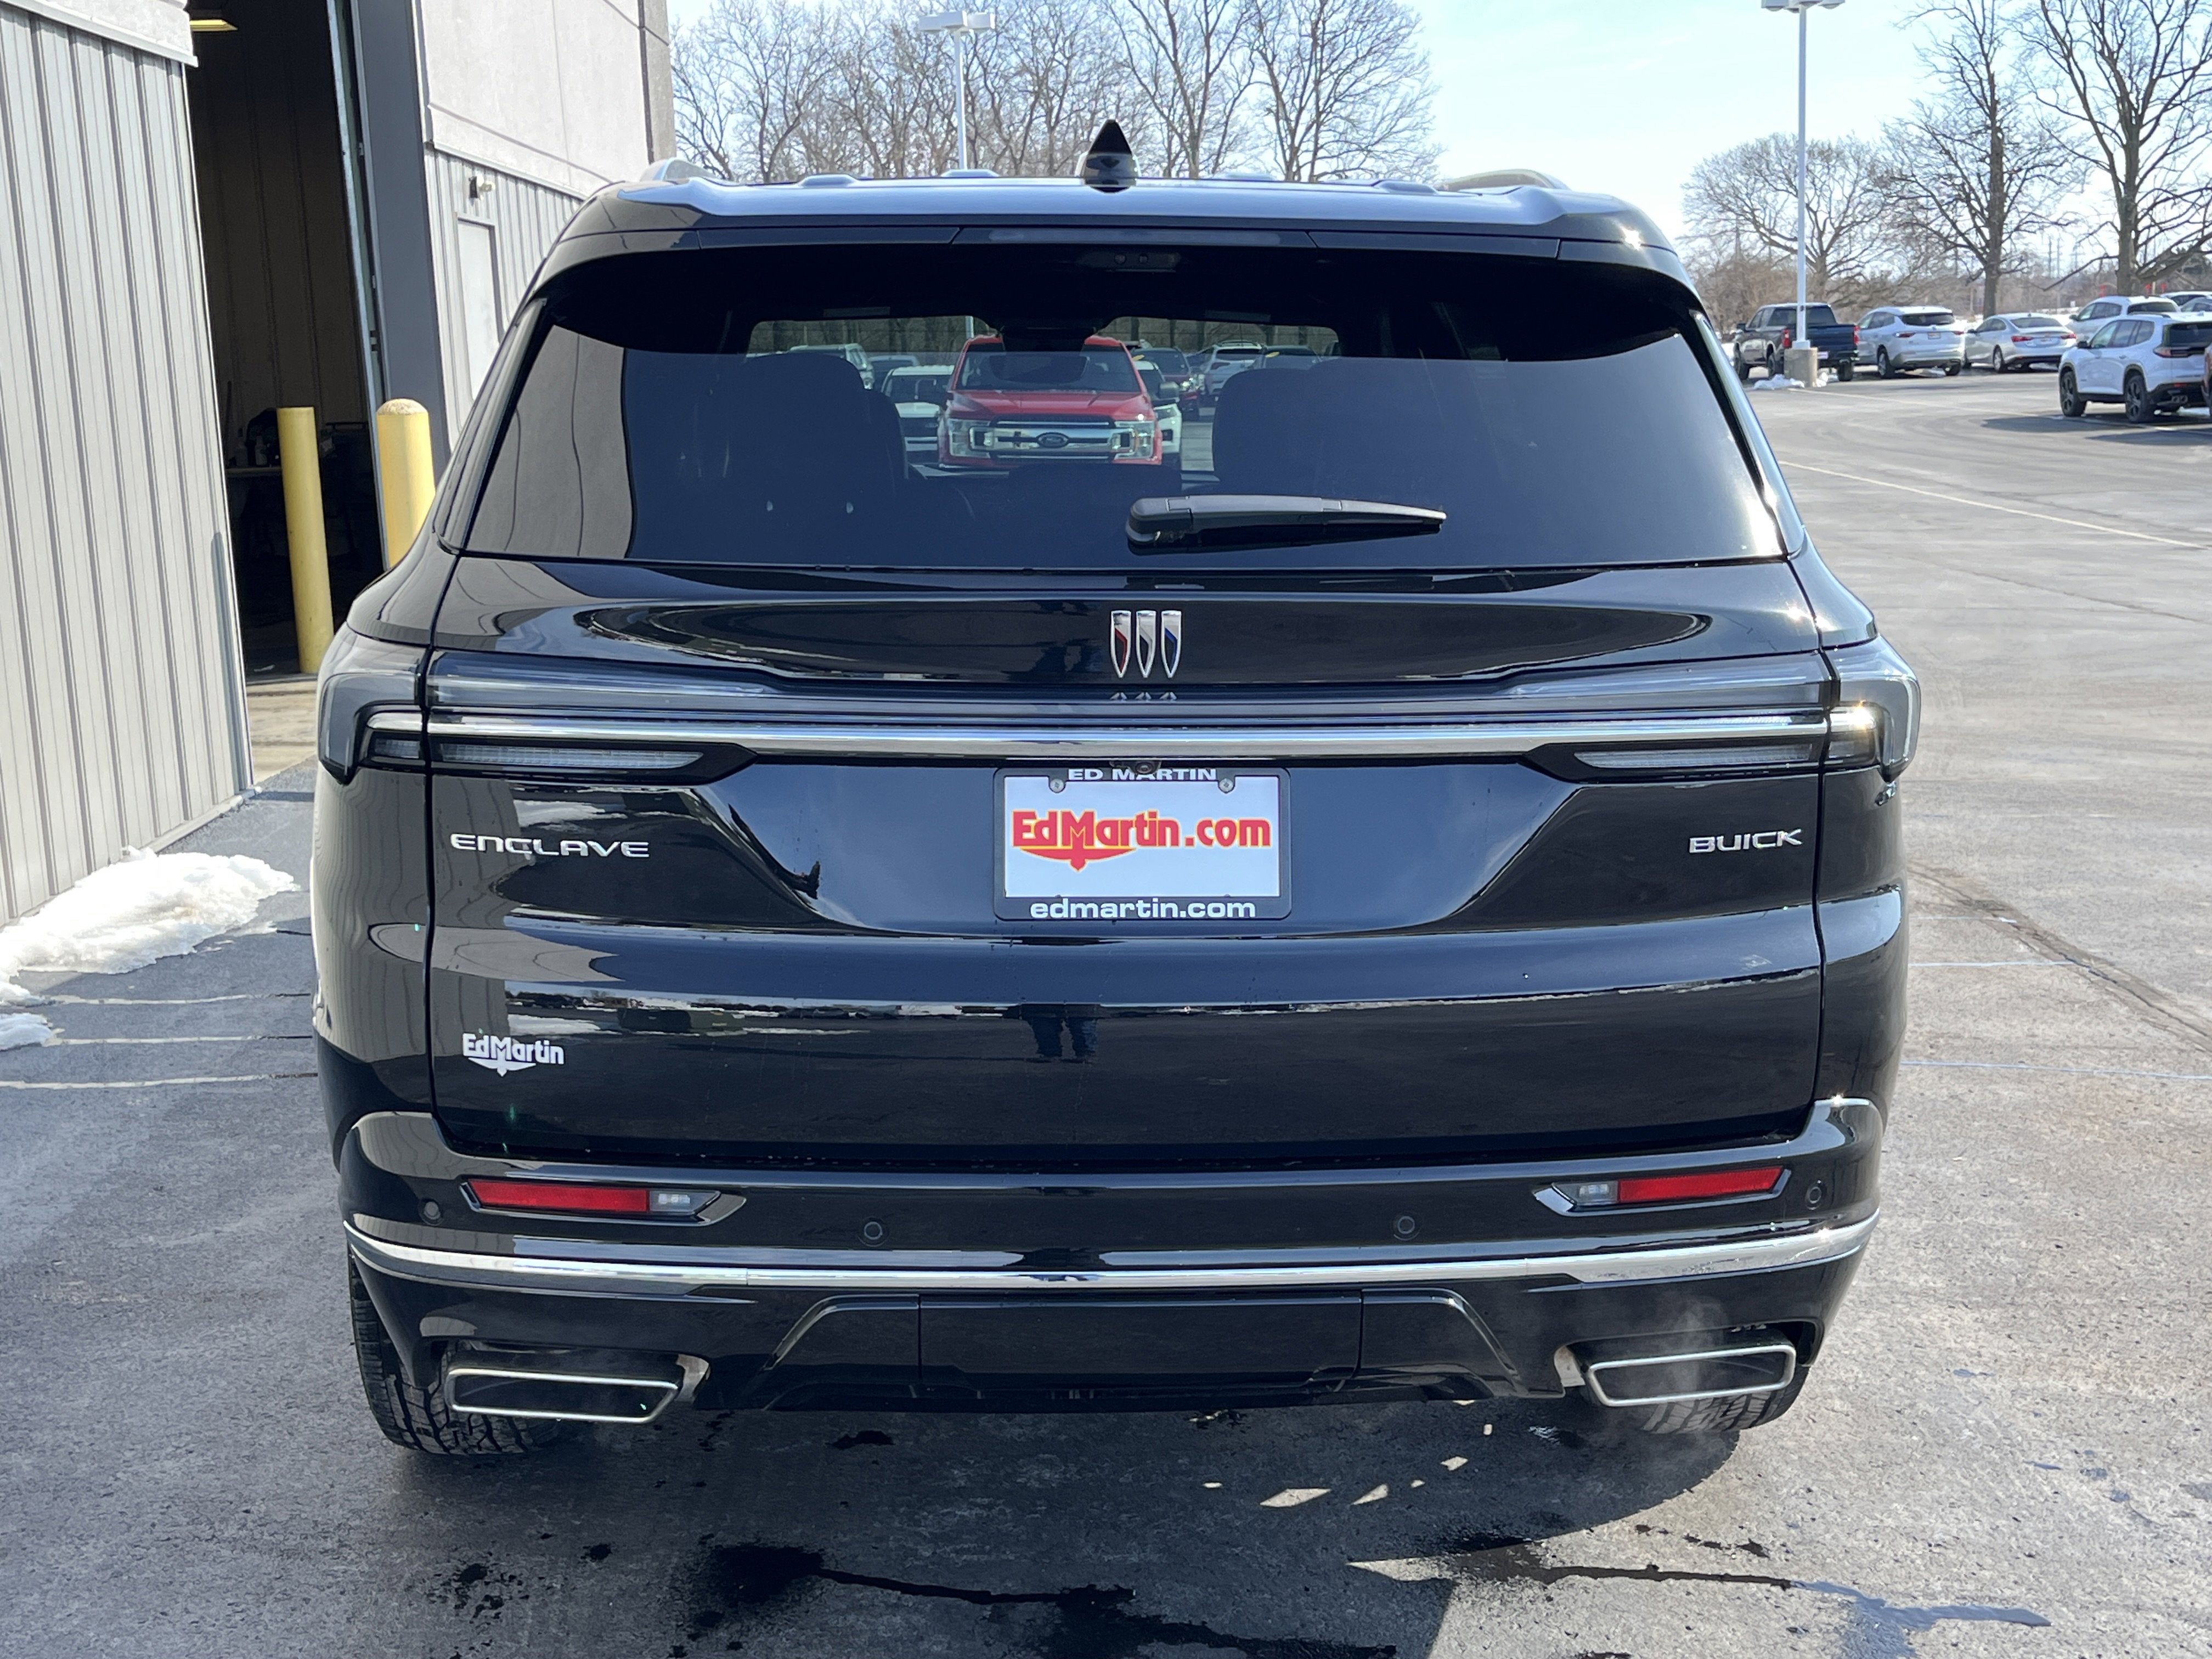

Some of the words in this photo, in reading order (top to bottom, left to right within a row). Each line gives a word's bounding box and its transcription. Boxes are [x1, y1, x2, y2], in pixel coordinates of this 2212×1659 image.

[1069, 769, 1103, 780] ED
[450, 833, 650, 857] ENCLAVE
[1689, 828, 1803, 853] BUICK
[1030, 898, 1256, 918] edmartin.com
